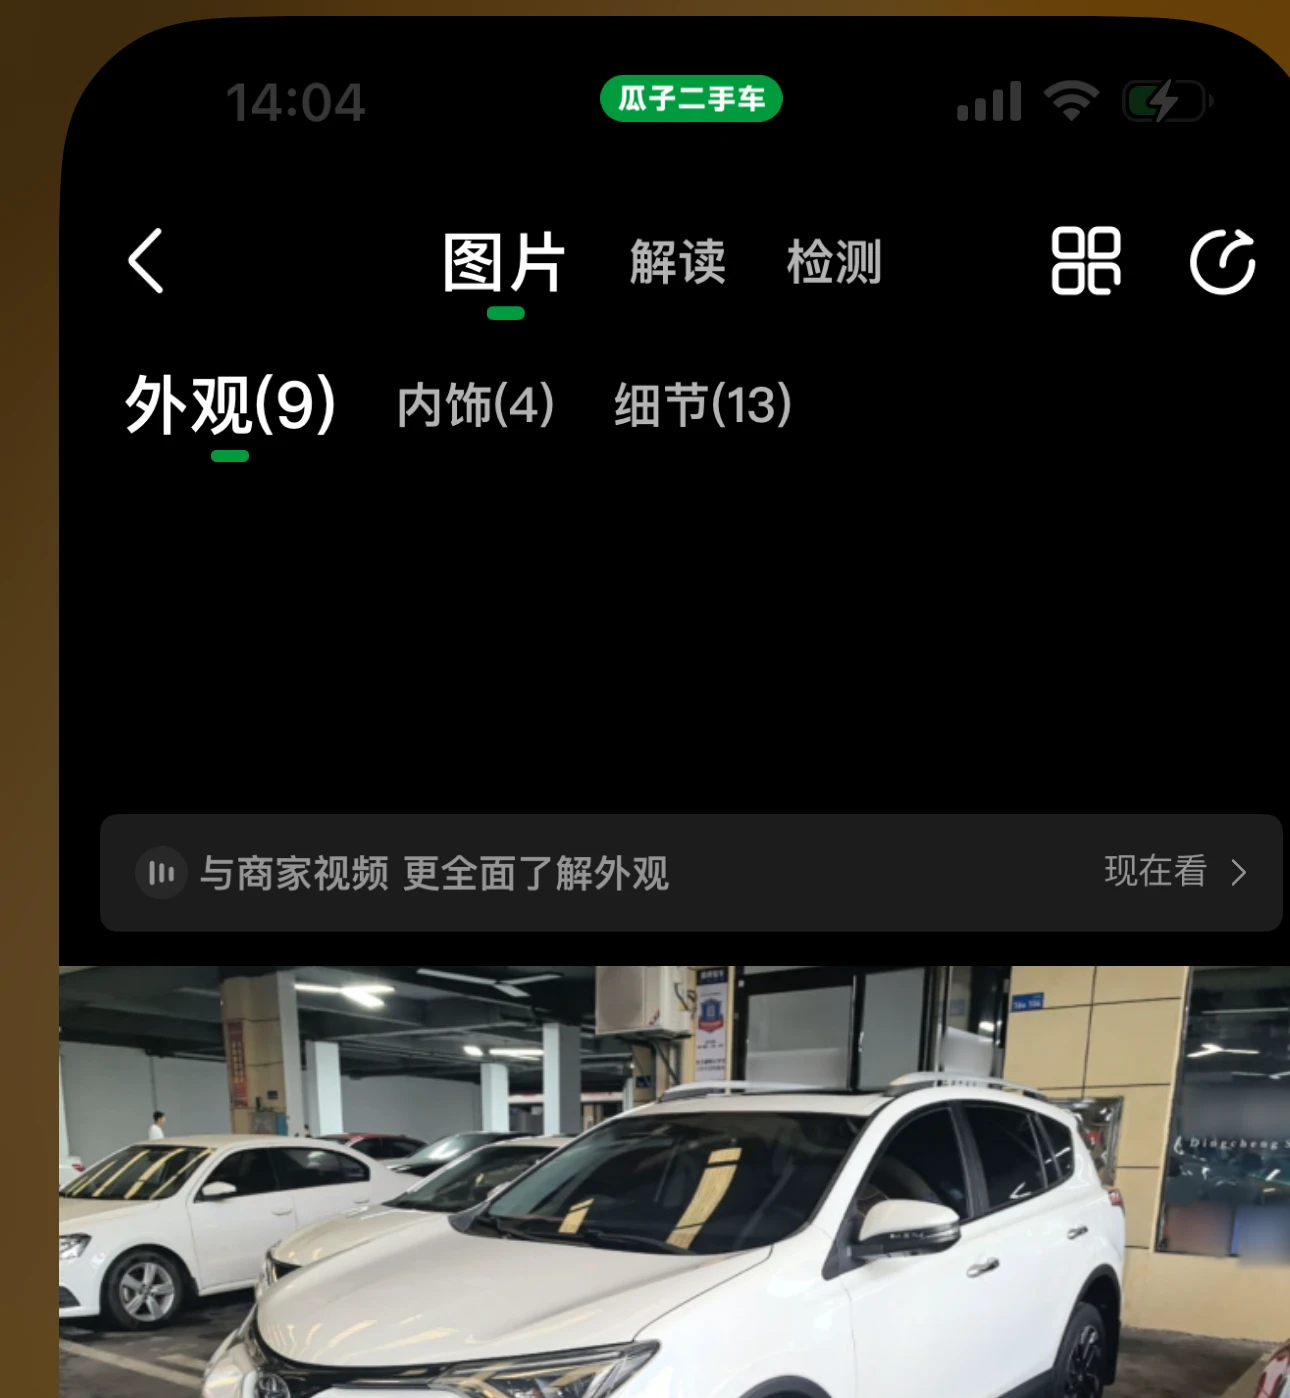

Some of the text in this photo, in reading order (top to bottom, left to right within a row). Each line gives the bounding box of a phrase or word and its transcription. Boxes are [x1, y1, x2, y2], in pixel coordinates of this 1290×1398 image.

[226, 82, 366, 123] 14:04
[618, 84, 766, 113] 瓜子二手车
[444, 230, 565, 293] 图片
[629, 237, 726, 285] 解读
[786, 238, 881, 285] 检测
[124, 373, 335, 437] 外观(9)
[398, 381, 554, 428] 内饰(4)
[614, 381, 791, 428] 细节(13)
[200, 854, 670, 892] 与商家视频 更全面了解外观
[1104, 852, 1208, 888] 现在看
